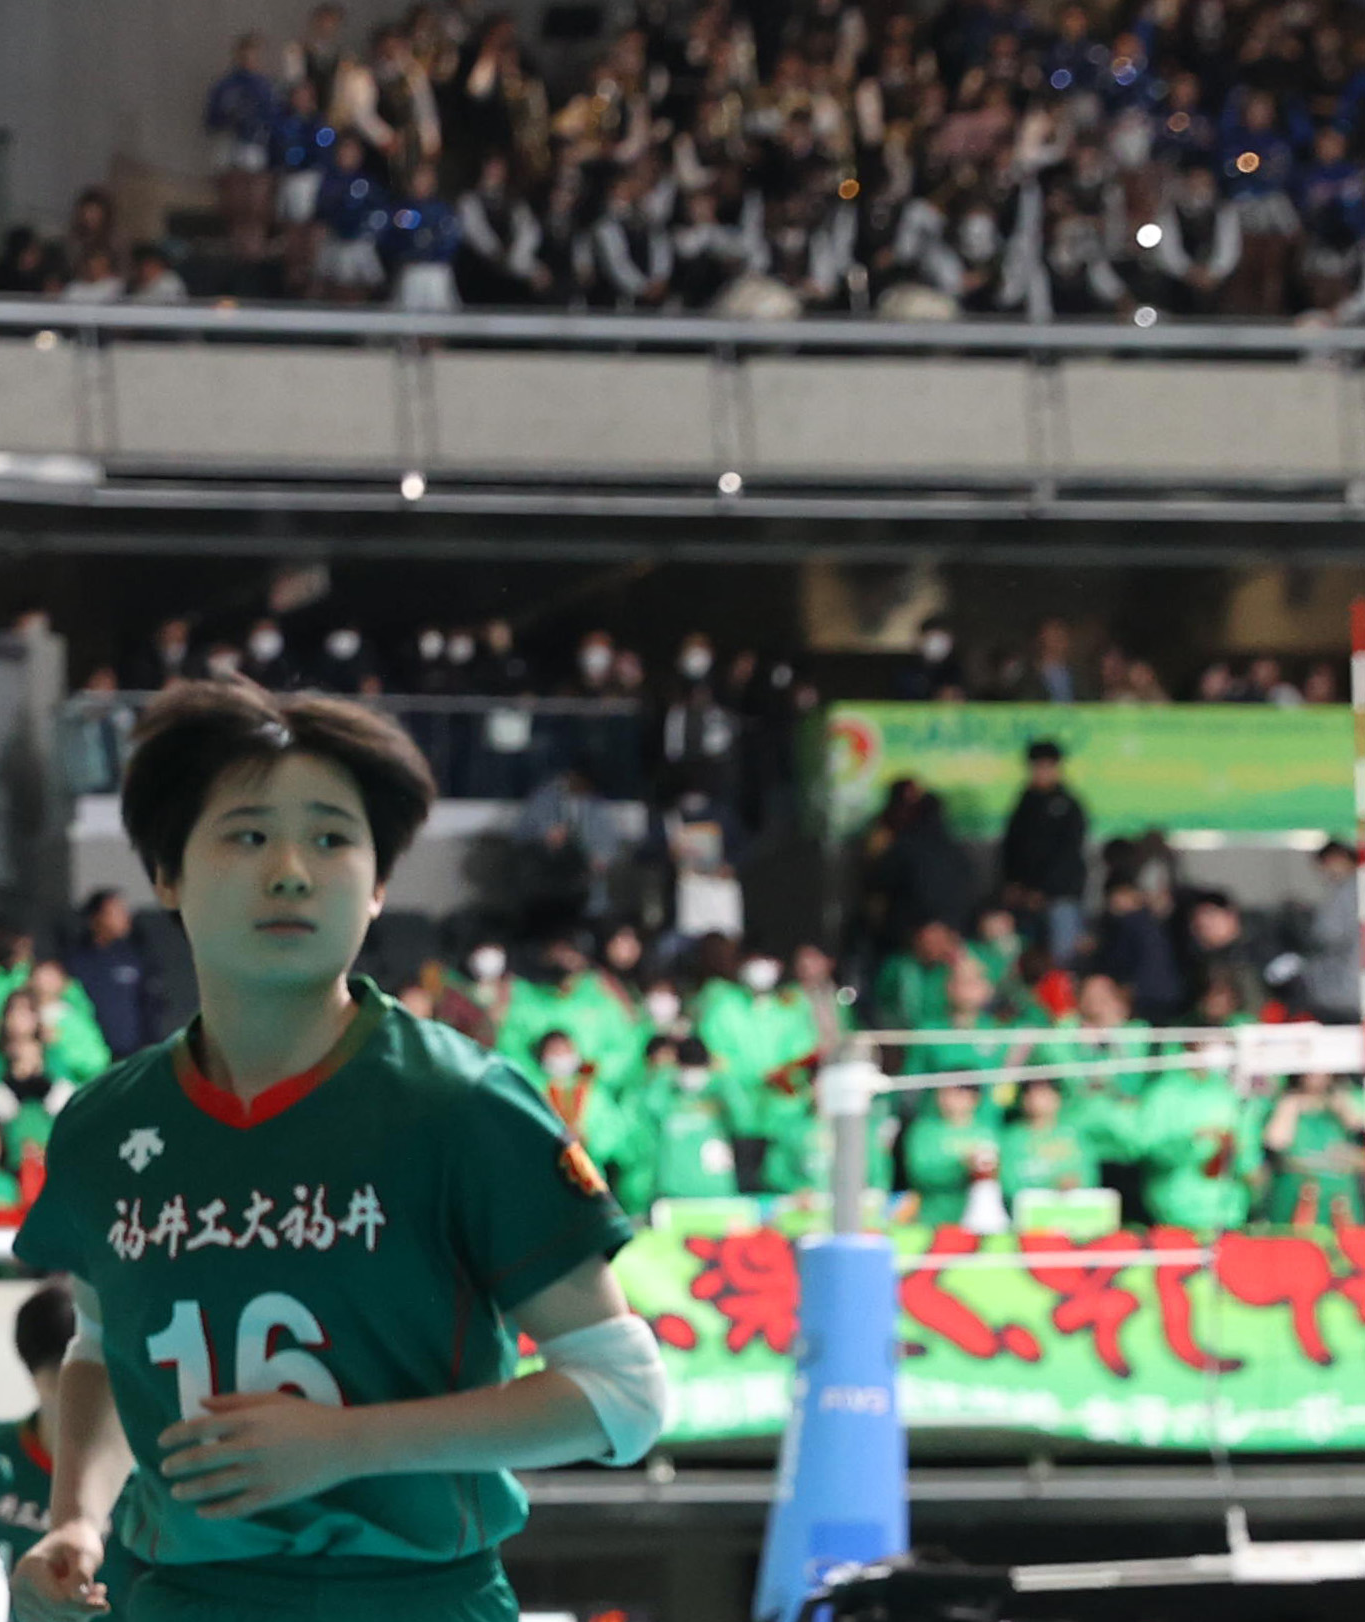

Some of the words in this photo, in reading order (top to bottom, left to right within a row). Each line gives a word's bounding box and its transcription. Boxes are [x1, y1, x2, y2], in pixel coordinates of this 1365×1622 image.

[108, 1183, 387, 1262] 福井工大福井
[146, 1291, 350, 1428] 16
